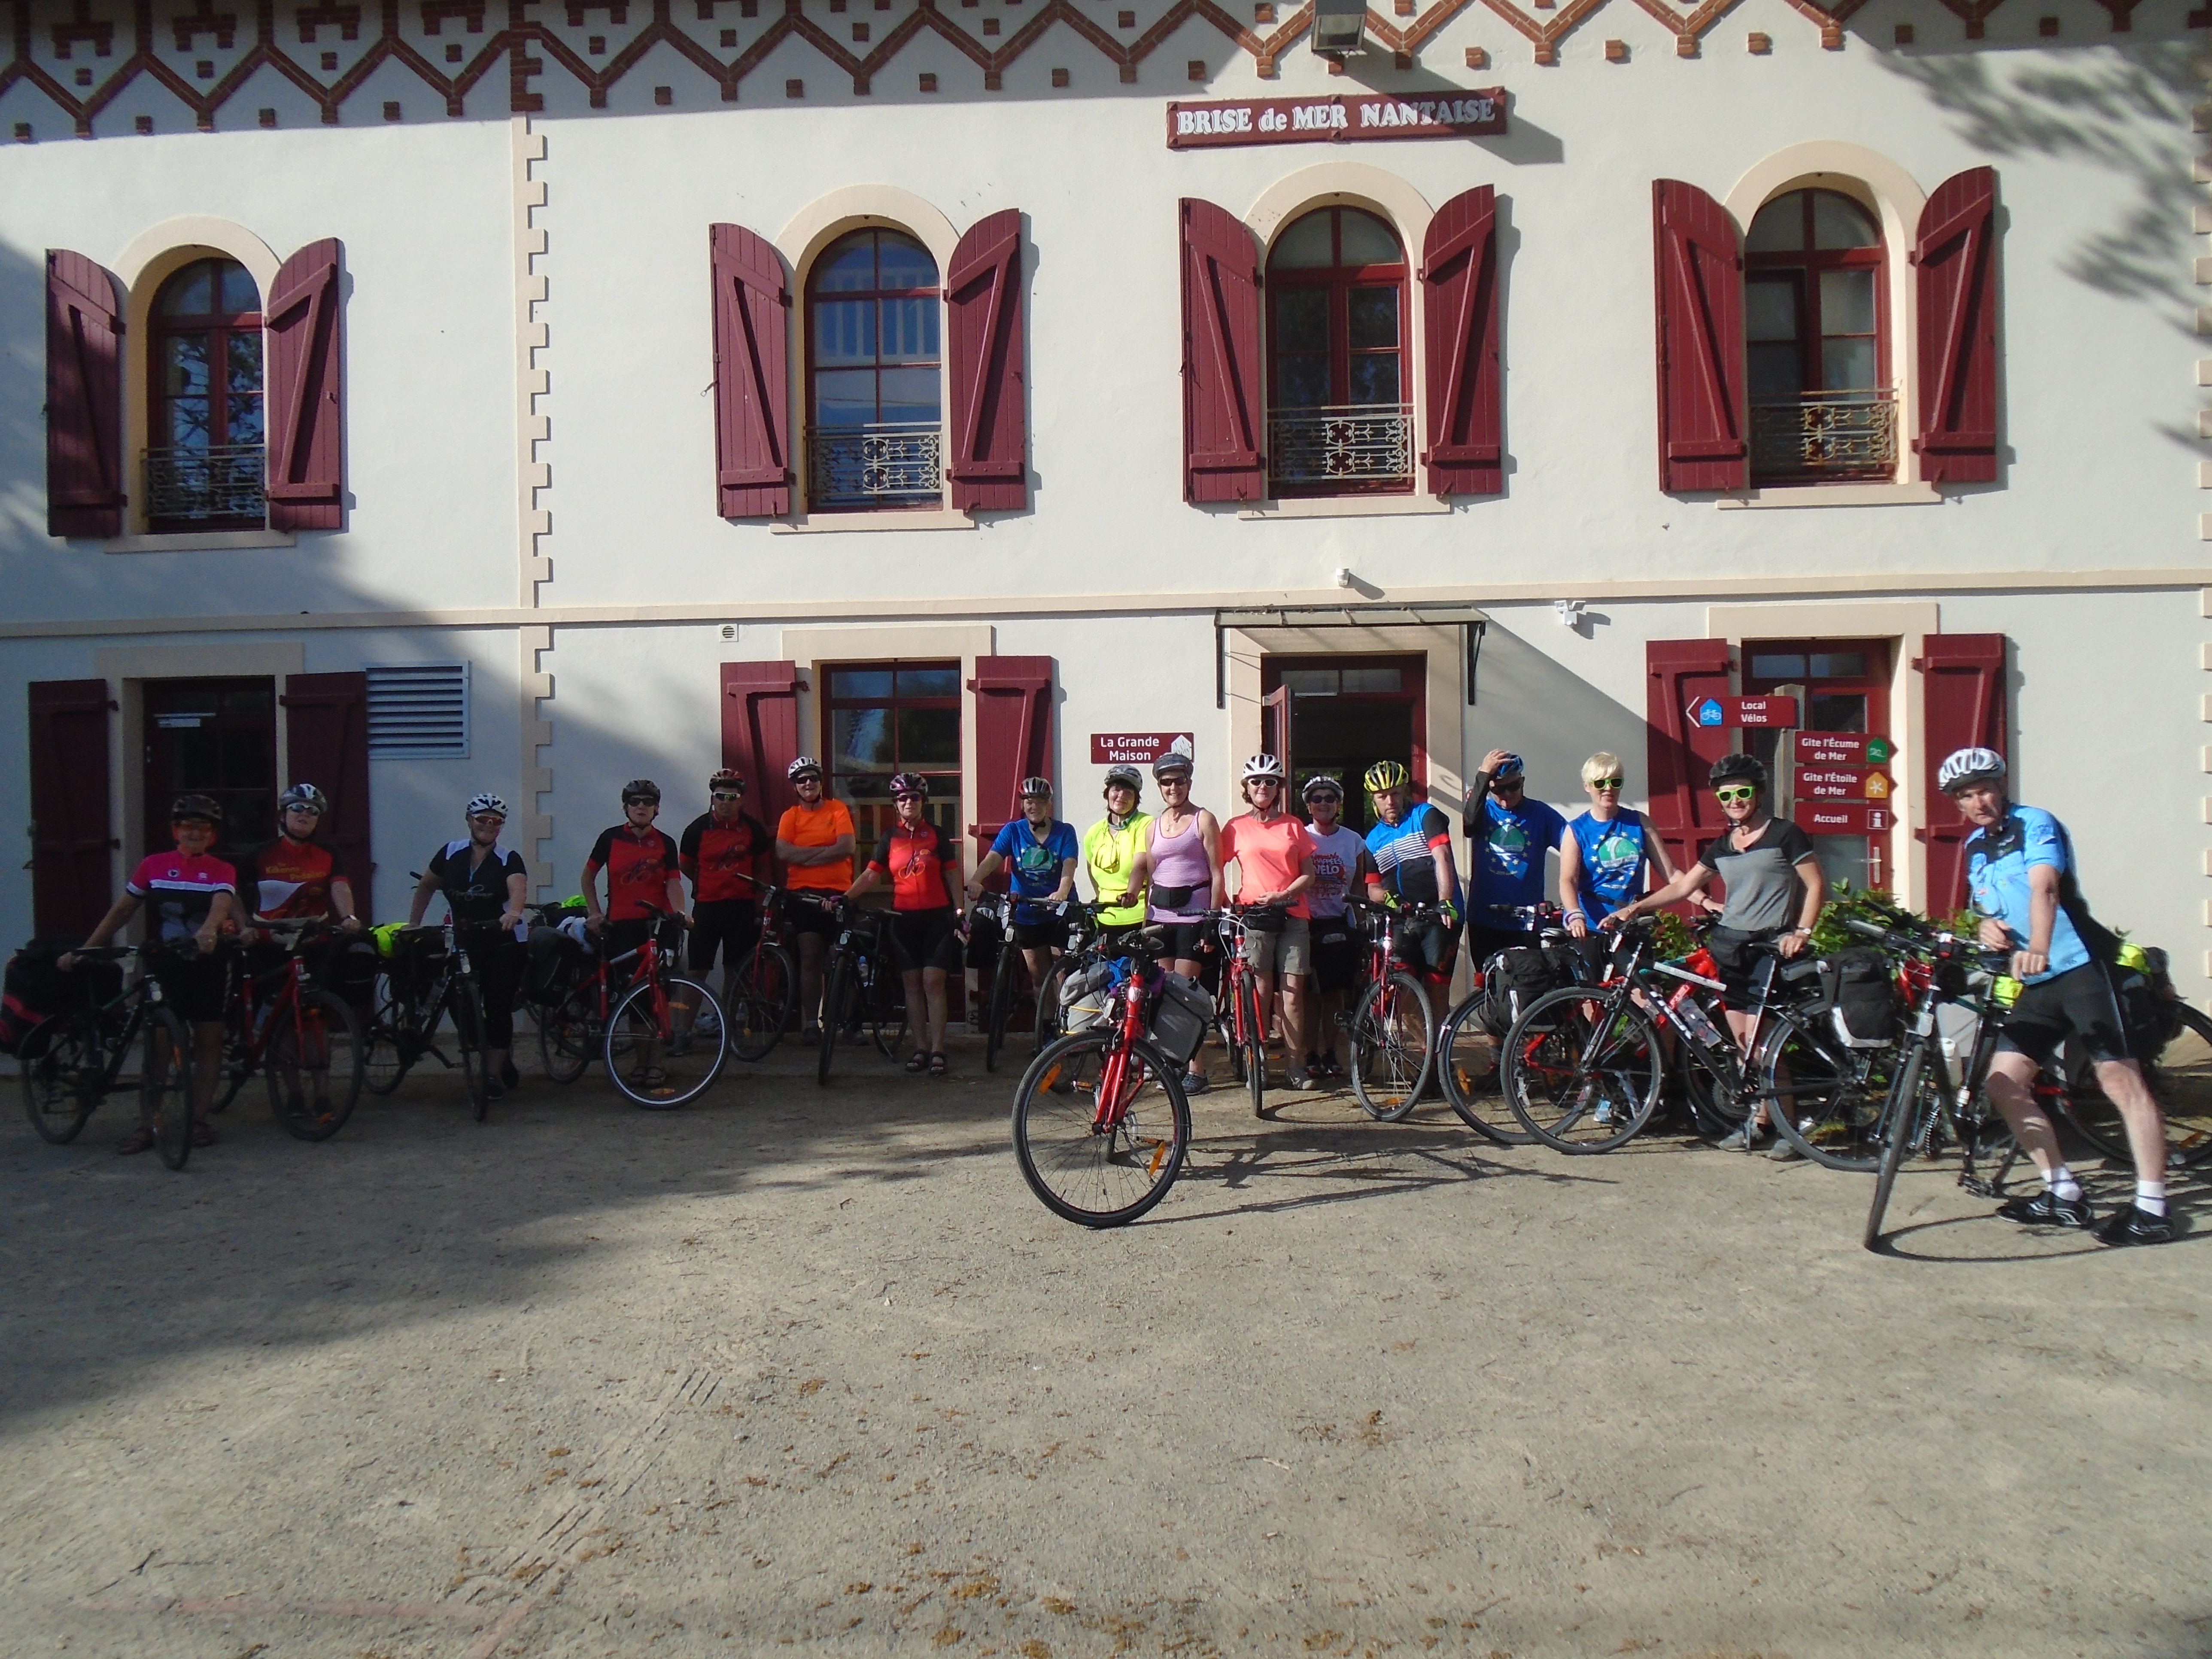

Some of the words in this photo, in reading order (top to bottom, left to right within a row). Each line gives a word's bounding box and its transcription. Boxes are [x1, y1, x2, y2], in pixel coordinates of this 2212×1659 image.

[1177, 108, 1252, 135] BRISE
[1258, 108, 1287, 132] de
[1292, 104, 1349, 131] MER
[1360, 98, 1495, 128] NANTAISE
[1741, 701, 1766, 710] Local
[1741, 713, 1767, 723] Vélos
[1100, 737, 1114, 747] La
[1118, 736, 1160, 747] Grande
[1823, 737, 1860, 748] l'Écume
[1109, 750, 1151, 761] Maison
[1814, 751, 1826, 760] de
[1829, 751, 1847, 760] Mer
[1825, 772, 1858, 783] l'Étoile
[1814, 786, 1826, 795] de
[1828, 786, 1847, 795] Mer
[1813, 814, 1848, 824] Accueil
